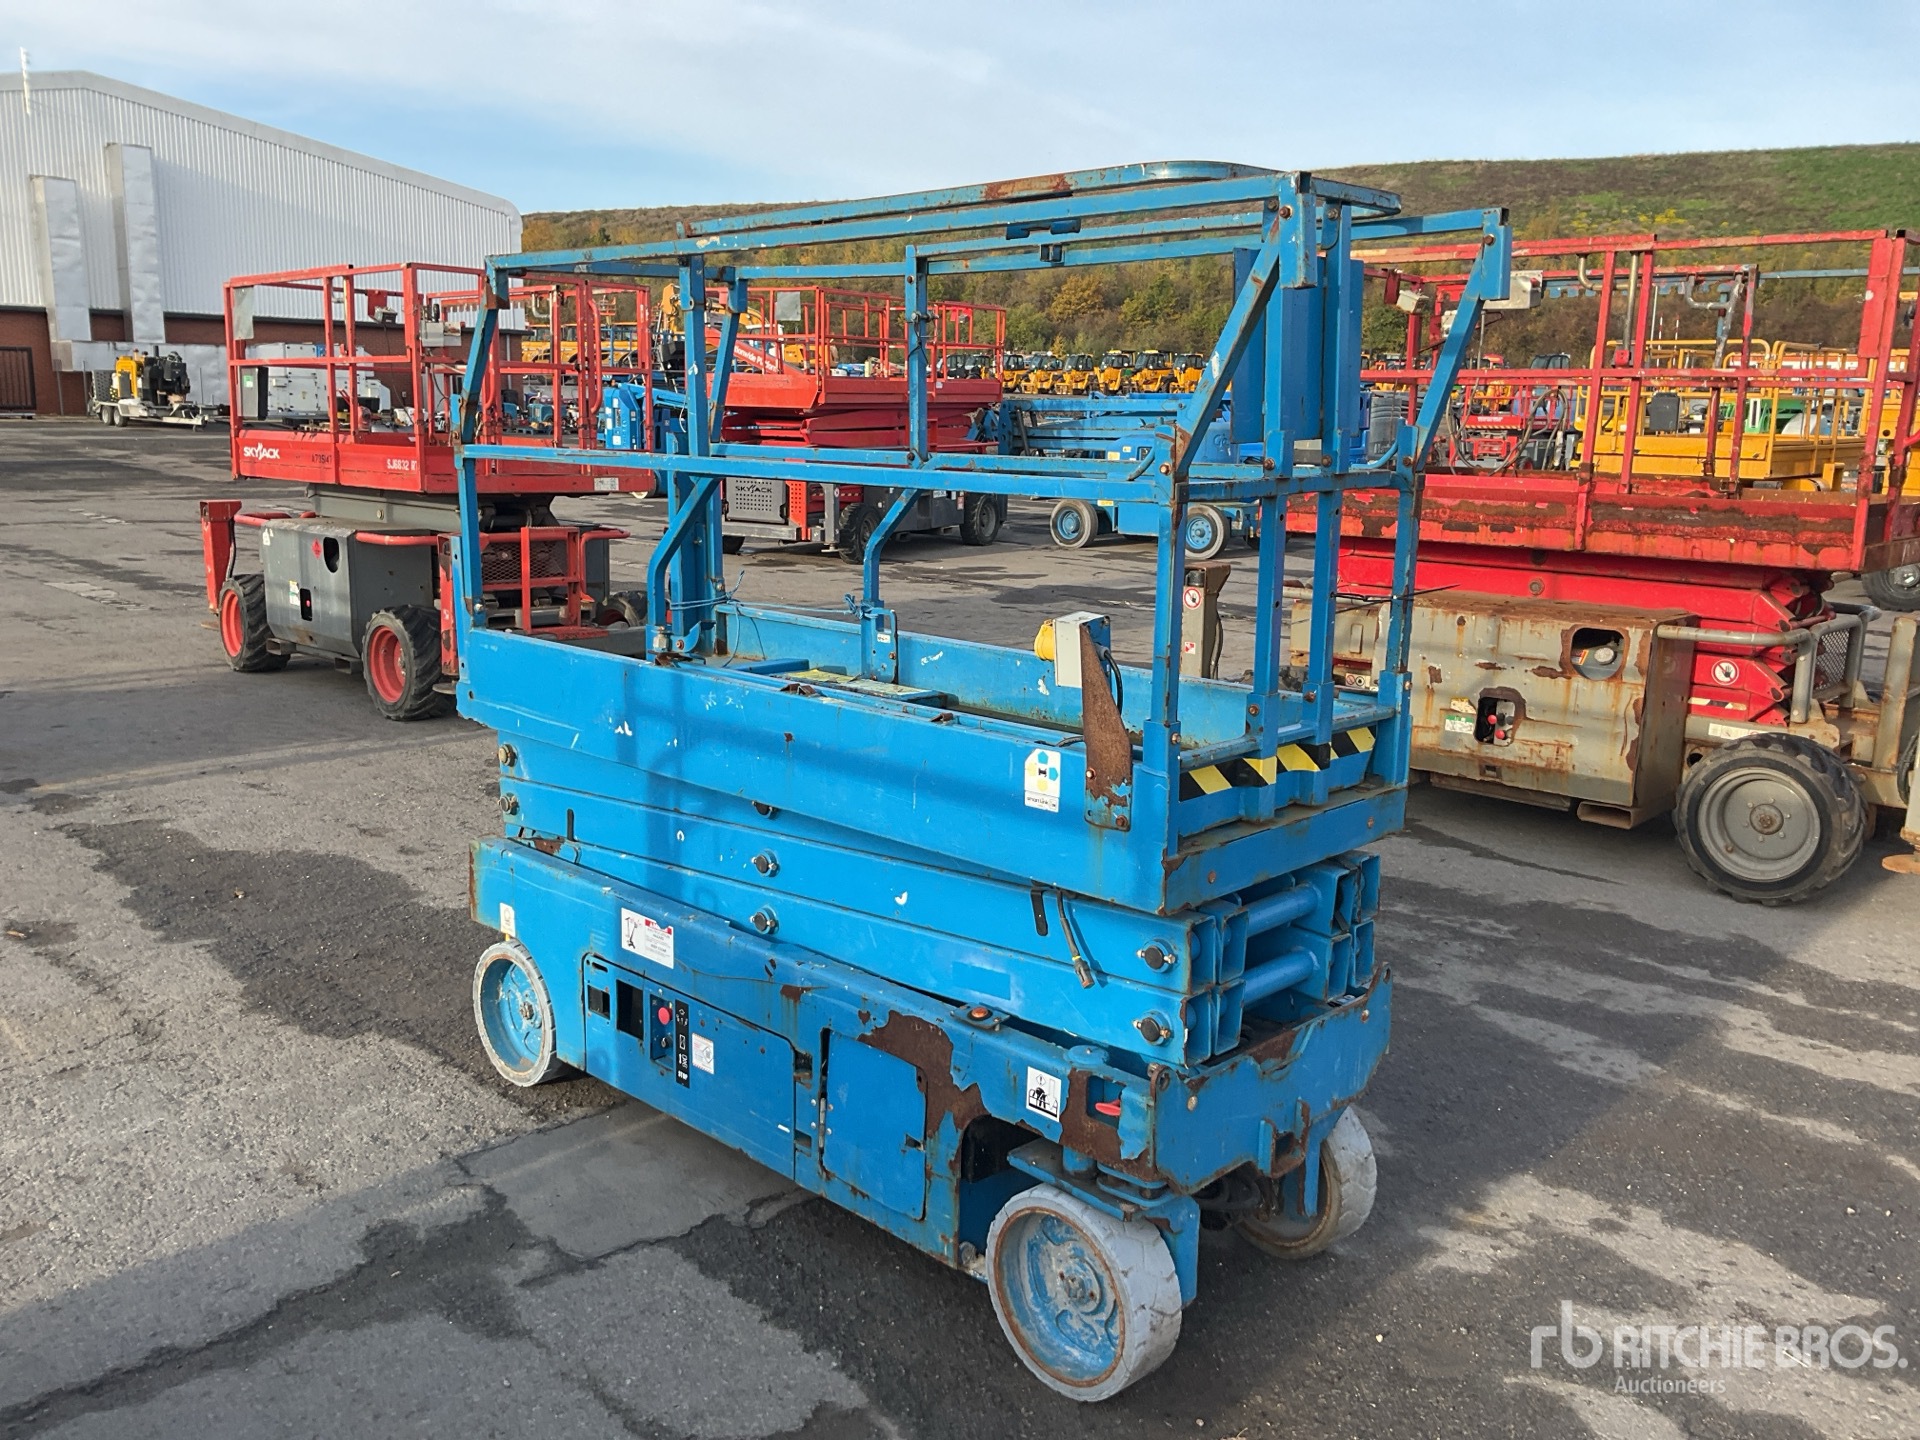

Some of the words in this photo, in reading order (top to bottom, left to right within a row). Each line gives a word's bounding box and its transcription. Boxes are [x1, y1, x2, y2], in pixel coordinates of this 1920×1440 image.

[243, 442, 280, 460] SKYJACK
[386, 458, 410, 471] SJ6832
[735, 485, 772, 493] SKYJACK
